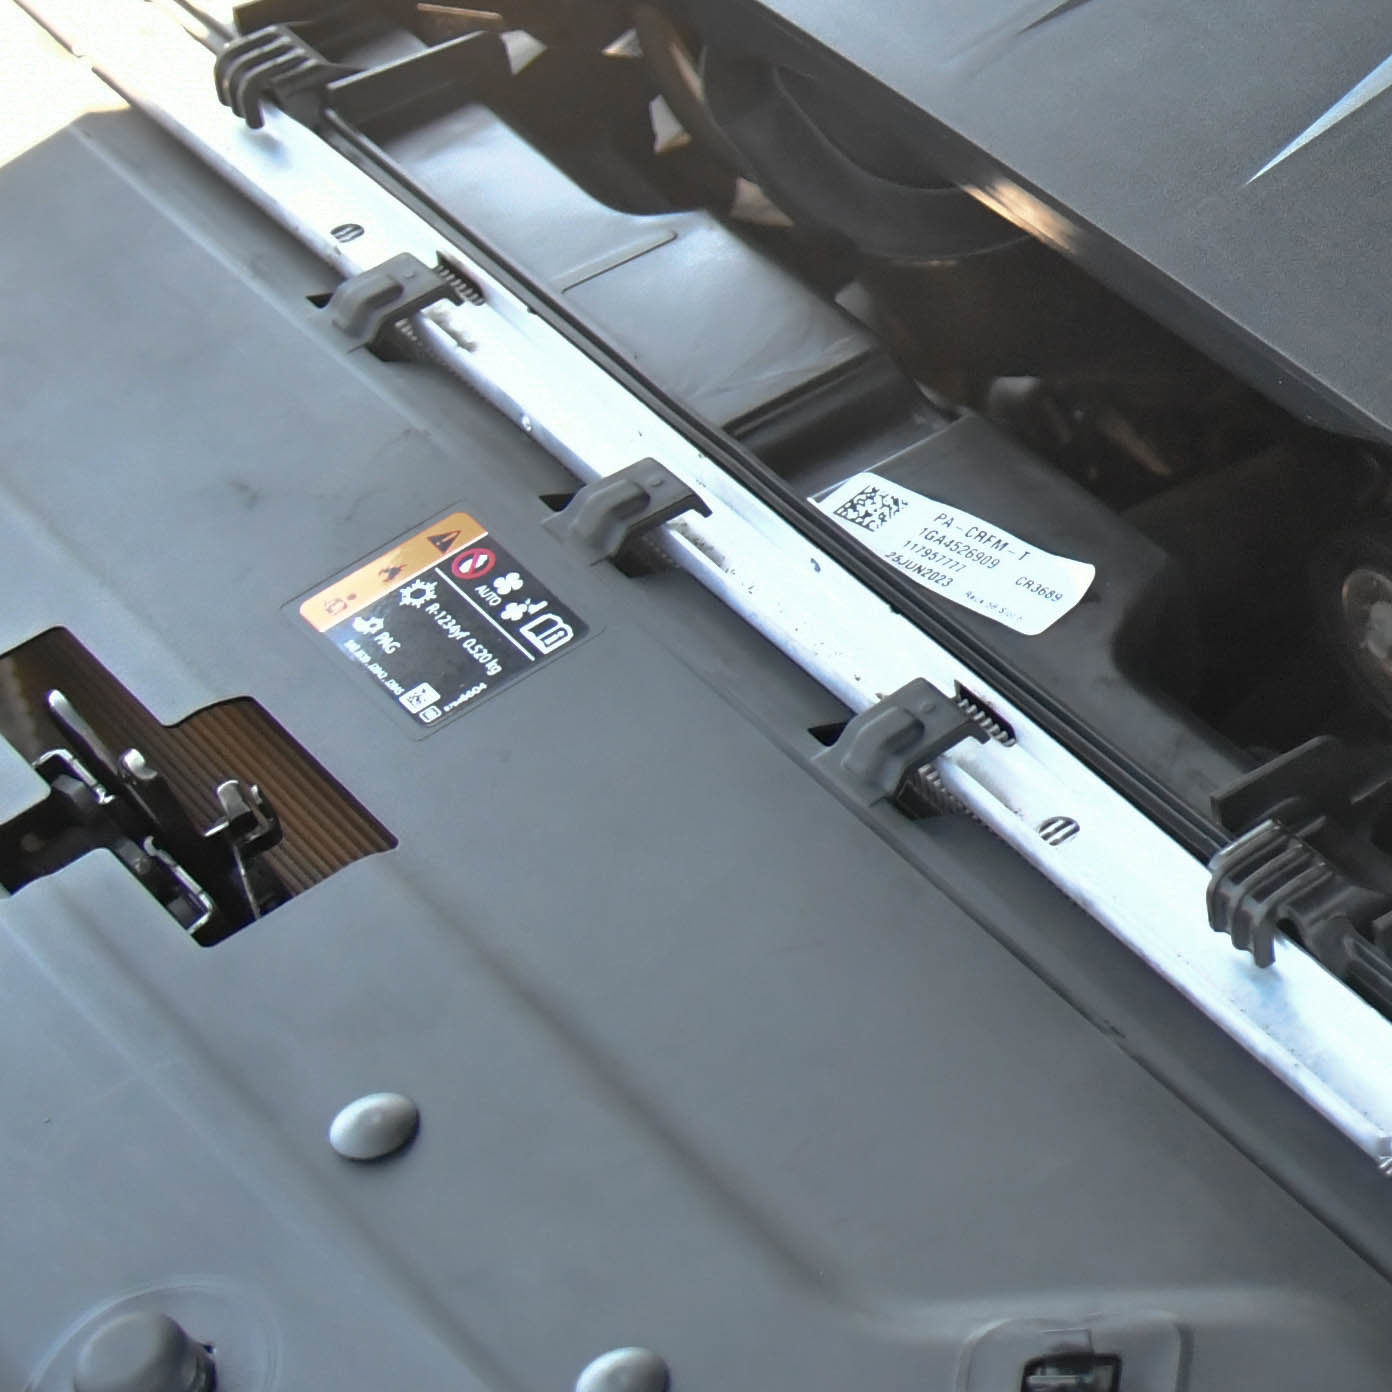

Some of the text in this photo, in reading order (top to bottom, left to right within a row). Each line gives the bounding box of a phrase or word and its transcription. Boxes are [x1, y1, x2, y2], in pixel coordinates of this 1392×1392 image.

[919, 527, 1001, 569] 1GA4526909
[475, 585, 502, 606] AUTO
[1015, 575, 1064, 603] CR3689
[374, 631, 401, 655] PAG
[462, 638, 492, 664] 0.520
[485, 658, 502, 676] kg
